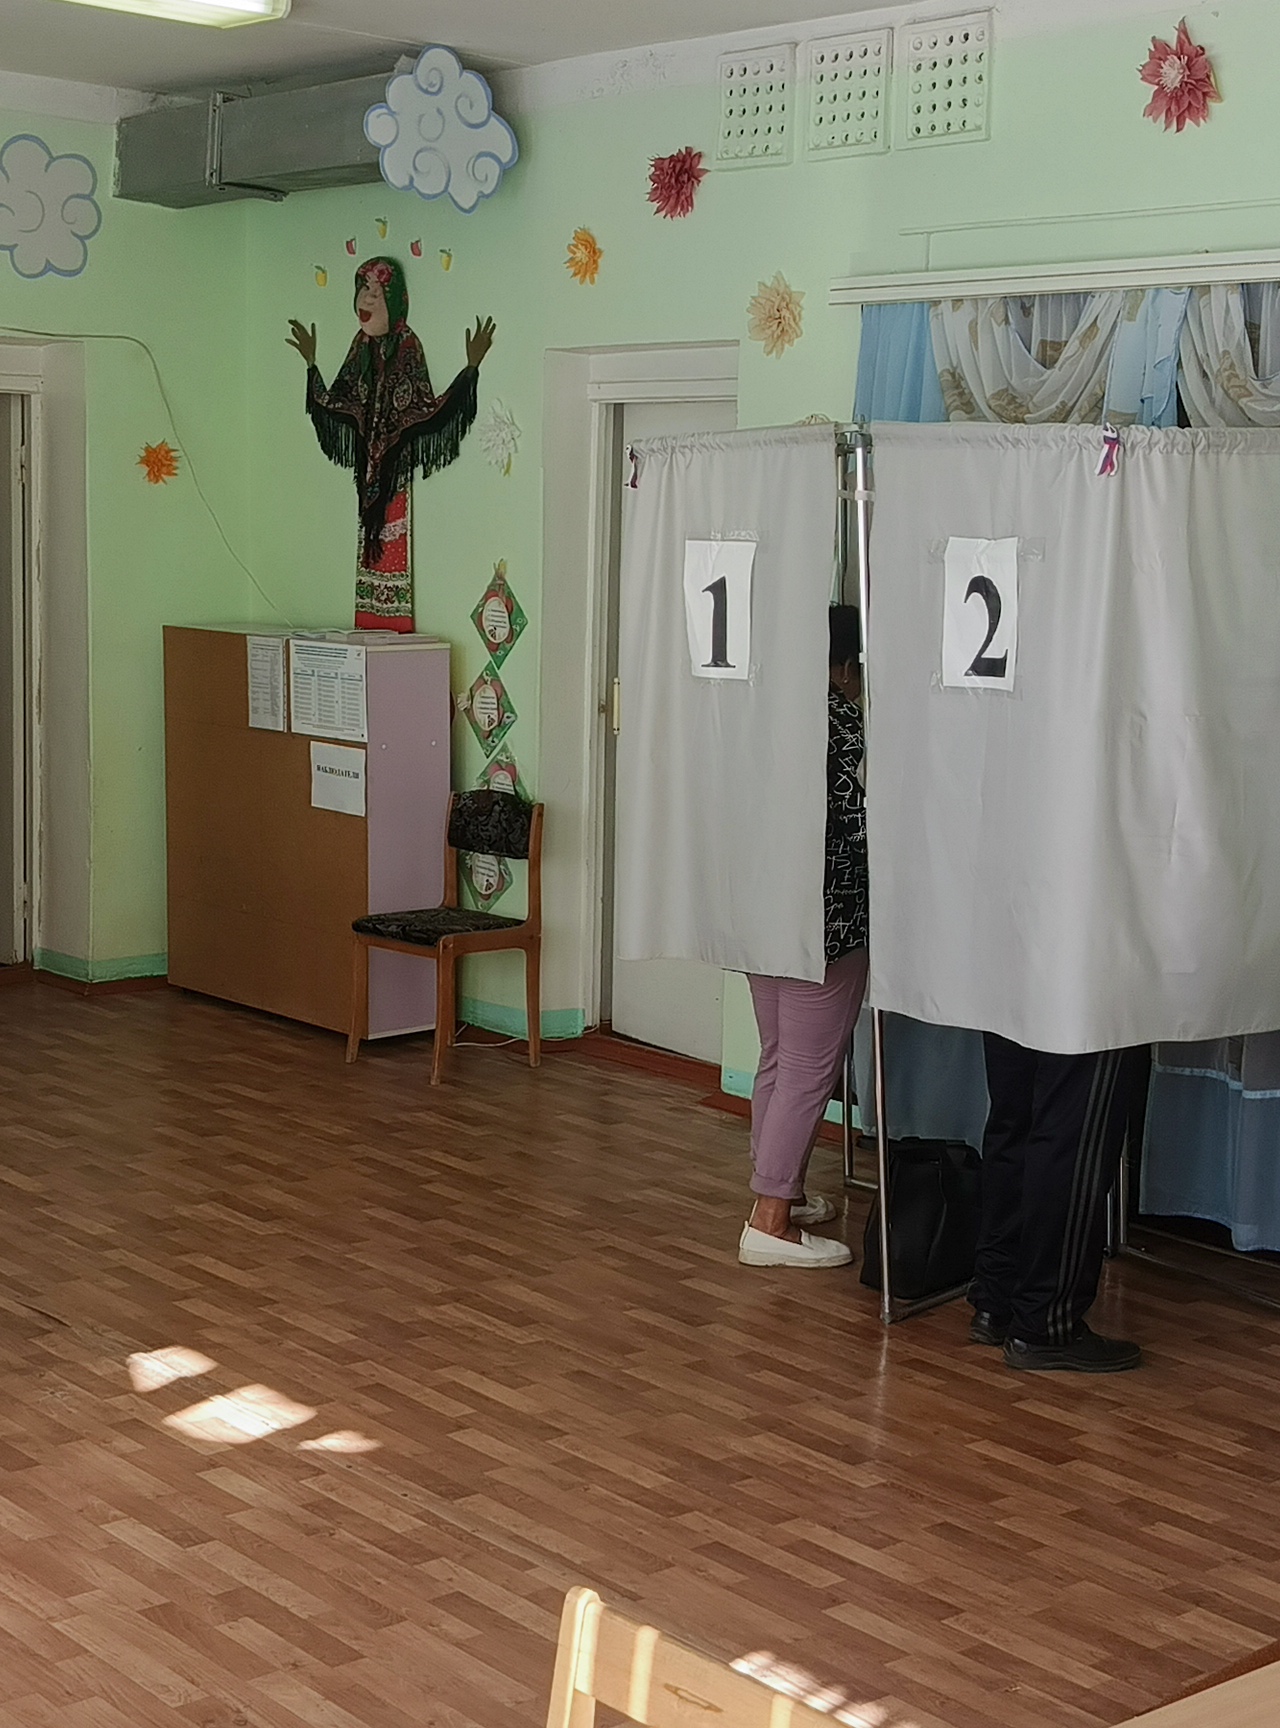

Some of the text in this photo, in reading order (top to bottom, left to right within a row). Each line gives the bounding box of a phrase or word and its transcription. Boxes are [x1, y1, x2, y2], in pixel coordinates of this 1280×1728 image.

[701, 575, 736, 669] 1
[963, 575, 1008, 678] 2
[316, 764, 360, 779] НАБЛЮДАТЕЛИ
